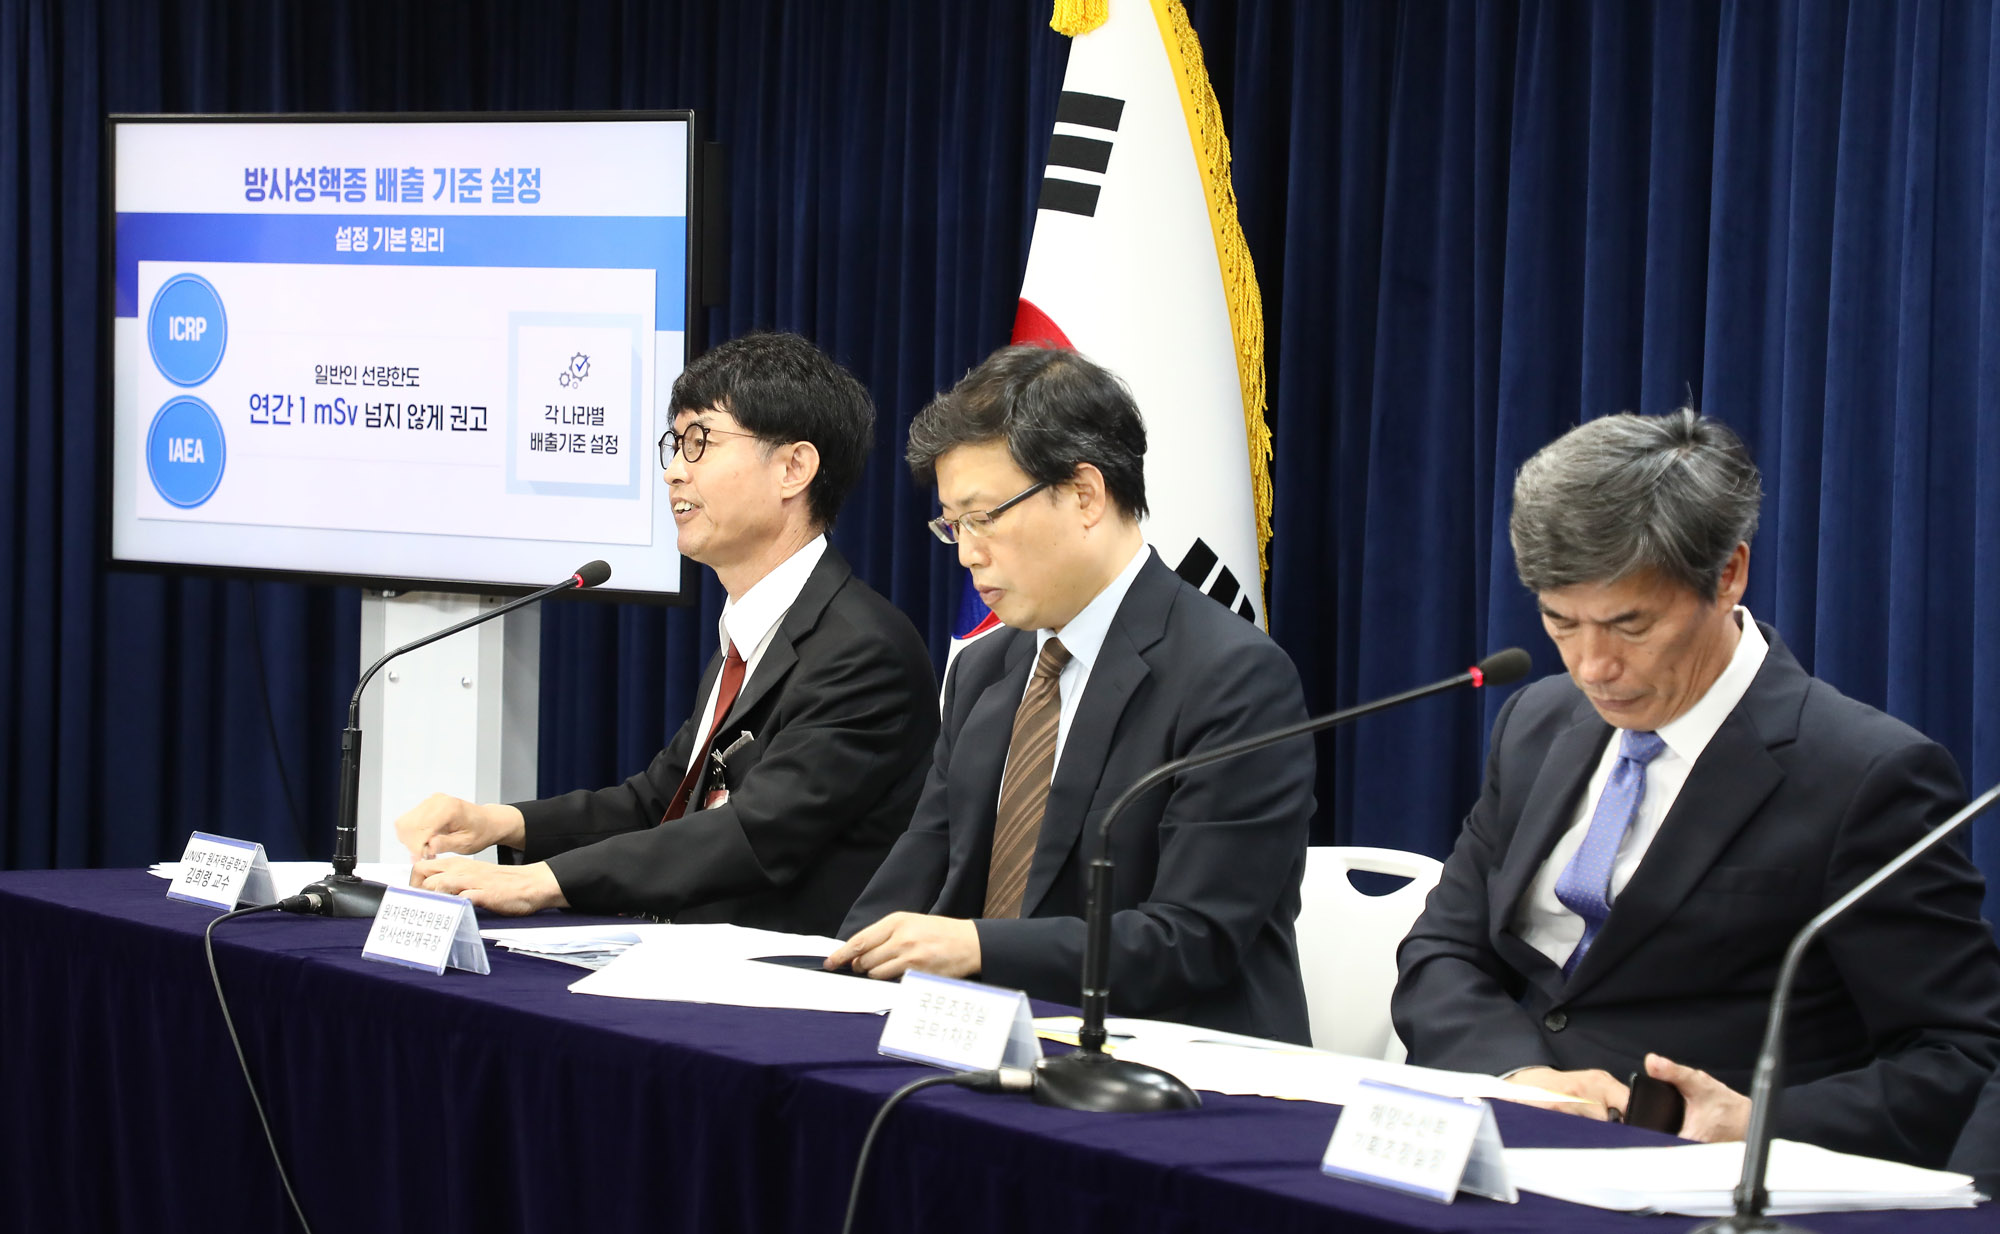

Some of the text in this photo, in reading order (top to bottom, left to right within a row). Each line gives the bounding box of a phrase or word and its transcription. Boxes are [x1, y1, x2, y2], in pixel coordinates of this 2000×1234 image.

[244, 166, 542, 204] 방사성핵종 배출 기준 설정
[335, 226, 445, 253] 설정 기본 원리
[169, 316, 207, 342] ICRP
[314, 364, 420, 387] 일반인 선량한도
[249, 394, 488, 432] 연간 1 mSv 넘지 않게 권고
[545, 405, 605, 427] 각 나라별
[168, 438, 204, 464] IAEA
[530, 432, 618, 455] 배출기준 설정
[184, 849, 249, 874] UNIST 원자력공학과
[211, 874, 230, 892] 교수
[381, 903, 454, 932] 원자력안전위원회
[378, 924, 442, 951] 방사선방재국장
